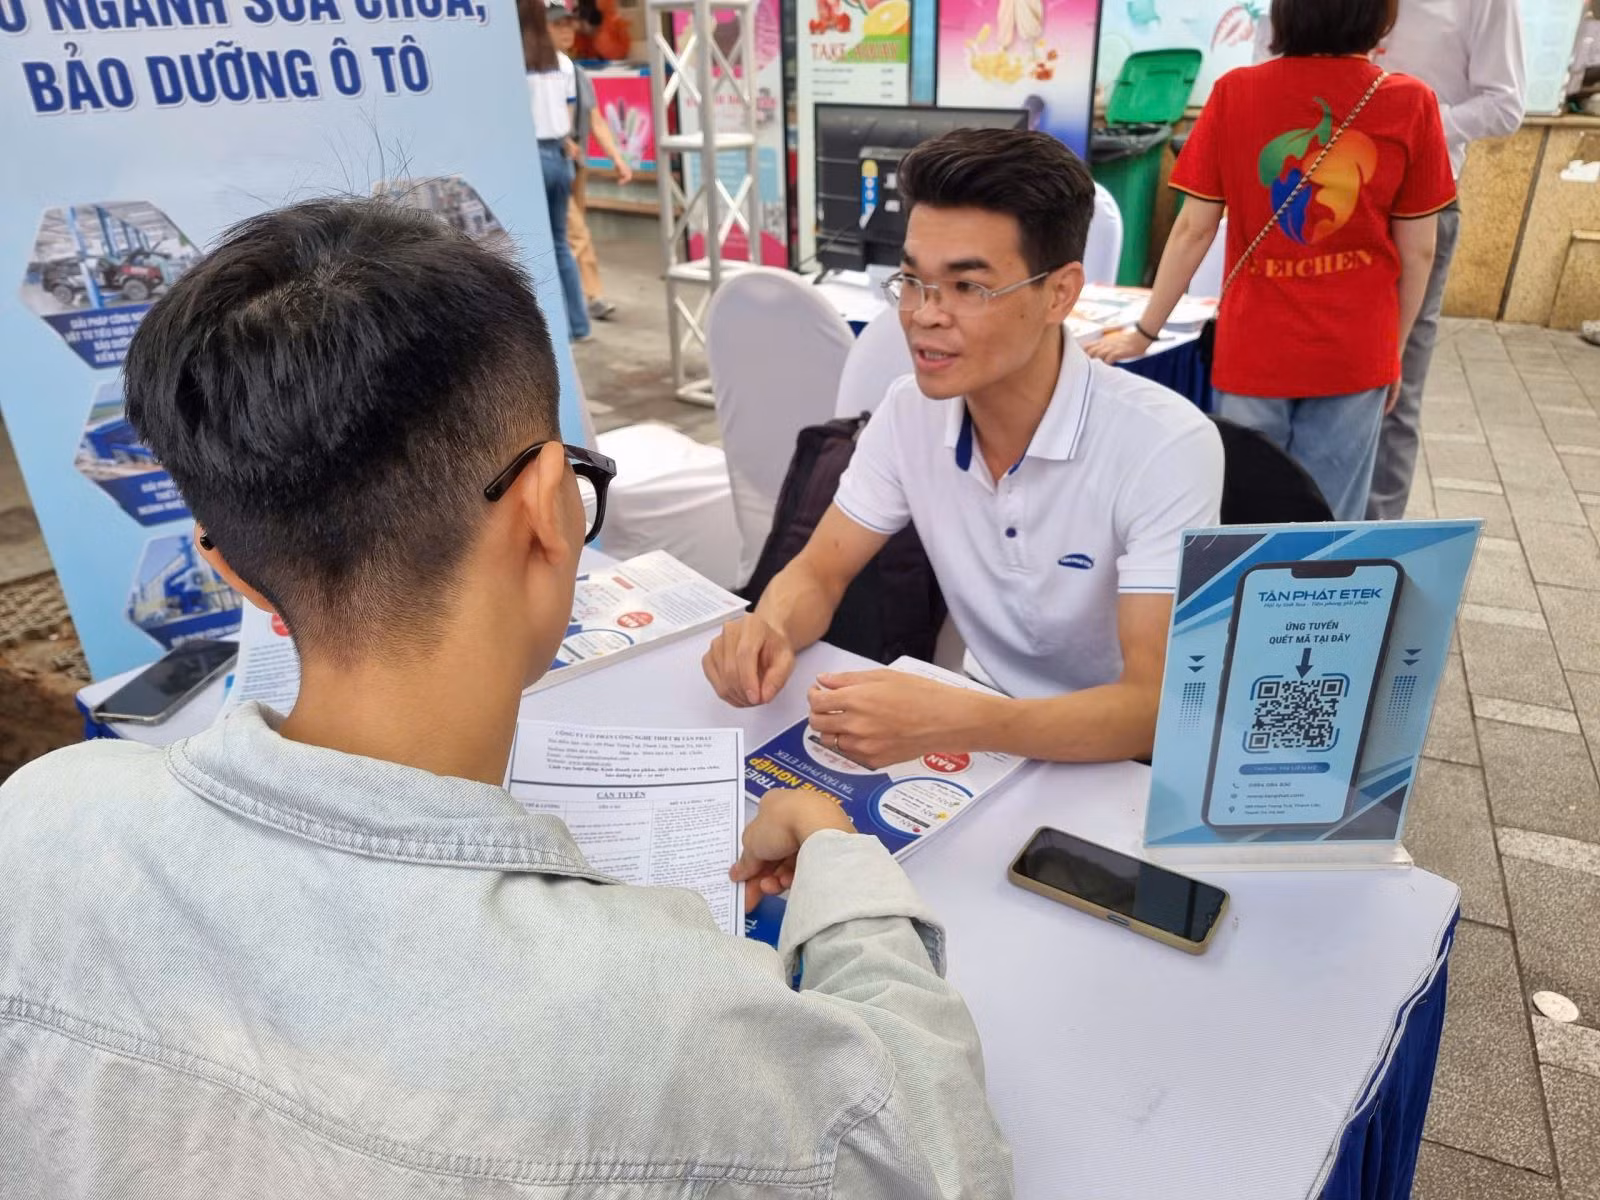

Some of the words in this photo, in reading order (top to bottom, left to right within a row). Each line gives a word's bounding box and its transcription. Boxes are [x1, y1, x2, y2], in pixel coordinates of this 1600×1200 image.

[22, 41, 135, 113] BẢO
[145, 40, 319, 105] DƯỠNG
[330, 37, 362, 96] Ô
[371, 35, 430, 94] TÔ
[1258, 588, 1292, 602] TÂN
[1292, 587, 1338, 601] PHÁT
[1339, 588, 1384, 600] ETEK
[1285, 621, 1306, 631] ỨNG
[1309, 620, 1340, 631] TUYỂN
[1269, 634, 1294, 645] QUÉT
[1295, 633, 1312, 644] MÃ
[1313, 635, 1329, 645] TẠI
[1330, 633, 1351, 644] ĐÂY
